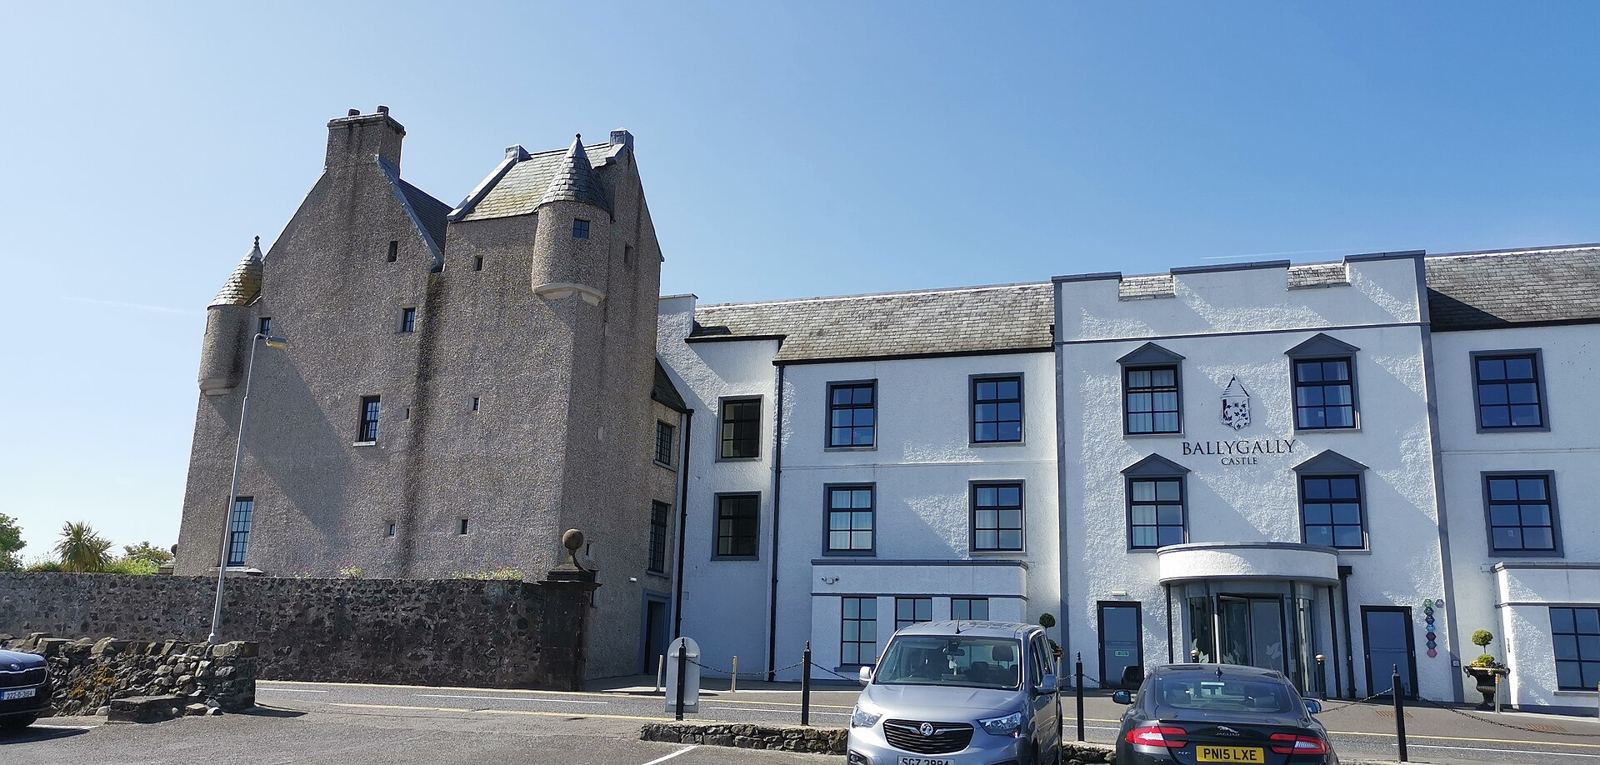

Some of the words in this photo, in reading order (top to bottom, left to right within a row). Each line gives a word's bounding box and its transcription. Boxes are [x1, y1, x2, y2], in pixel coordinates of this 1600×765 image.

[1181, 439, 1296, 456] BALLYGALLY
[1221, 457, 1258, 466] CASTLE
[1203, 748, 1231, 760] PN15
[1233, 749, 1257, 761] LXE
